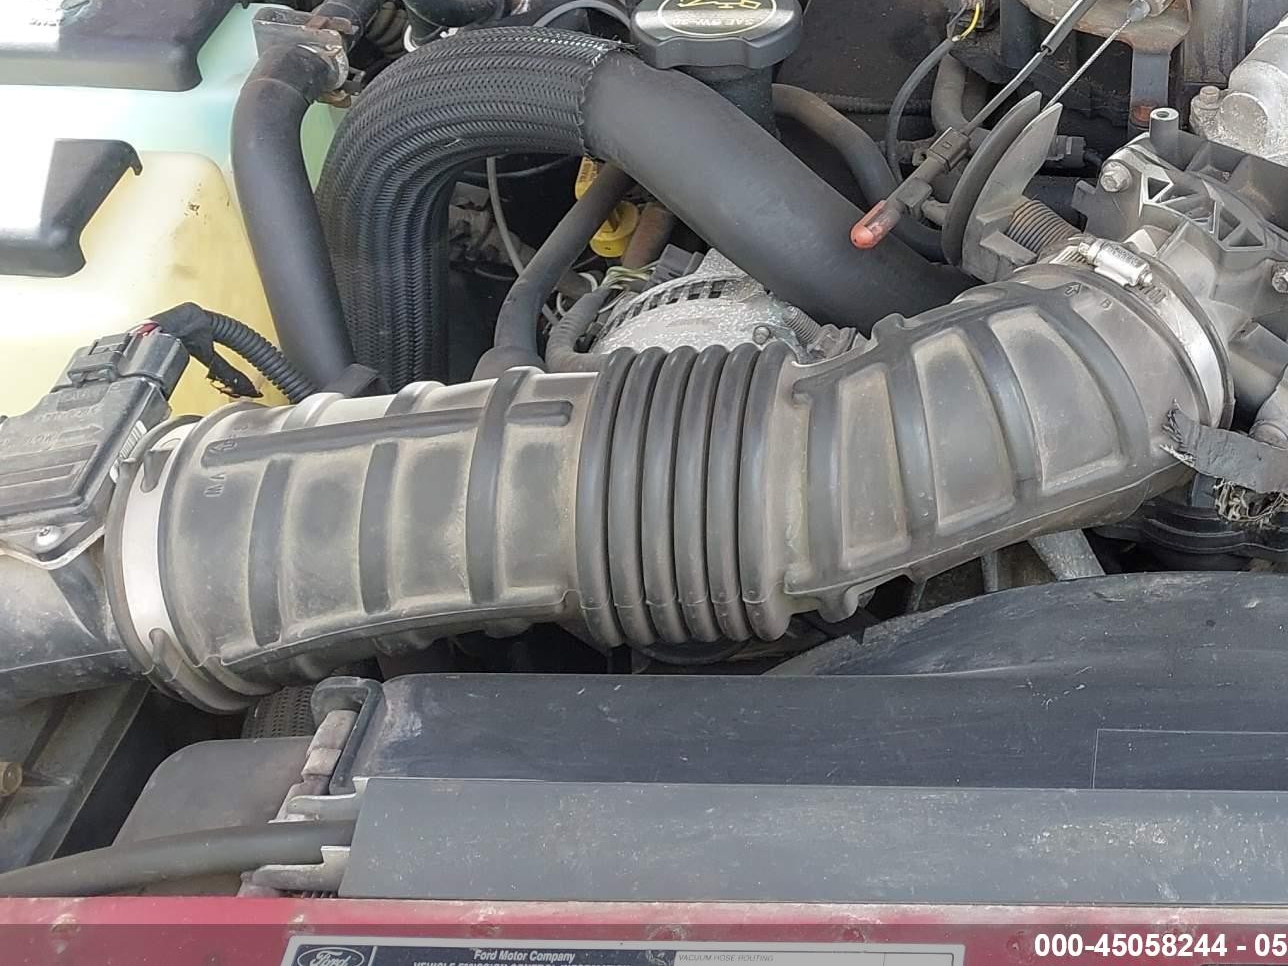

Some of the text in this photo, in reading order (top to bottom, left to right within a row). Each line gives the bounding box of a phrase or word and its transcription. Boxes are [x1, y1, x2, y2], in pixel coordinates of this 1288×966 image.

[724, 17, 755, 26] SAE
[474, 949, 497, 960] Ford
[498, 950, 528, 961] Motor
[530, 950, 576, 964] Company
[678, 953, 712, 962] VACUUM
[713, 954, 736, 962] HOSE
